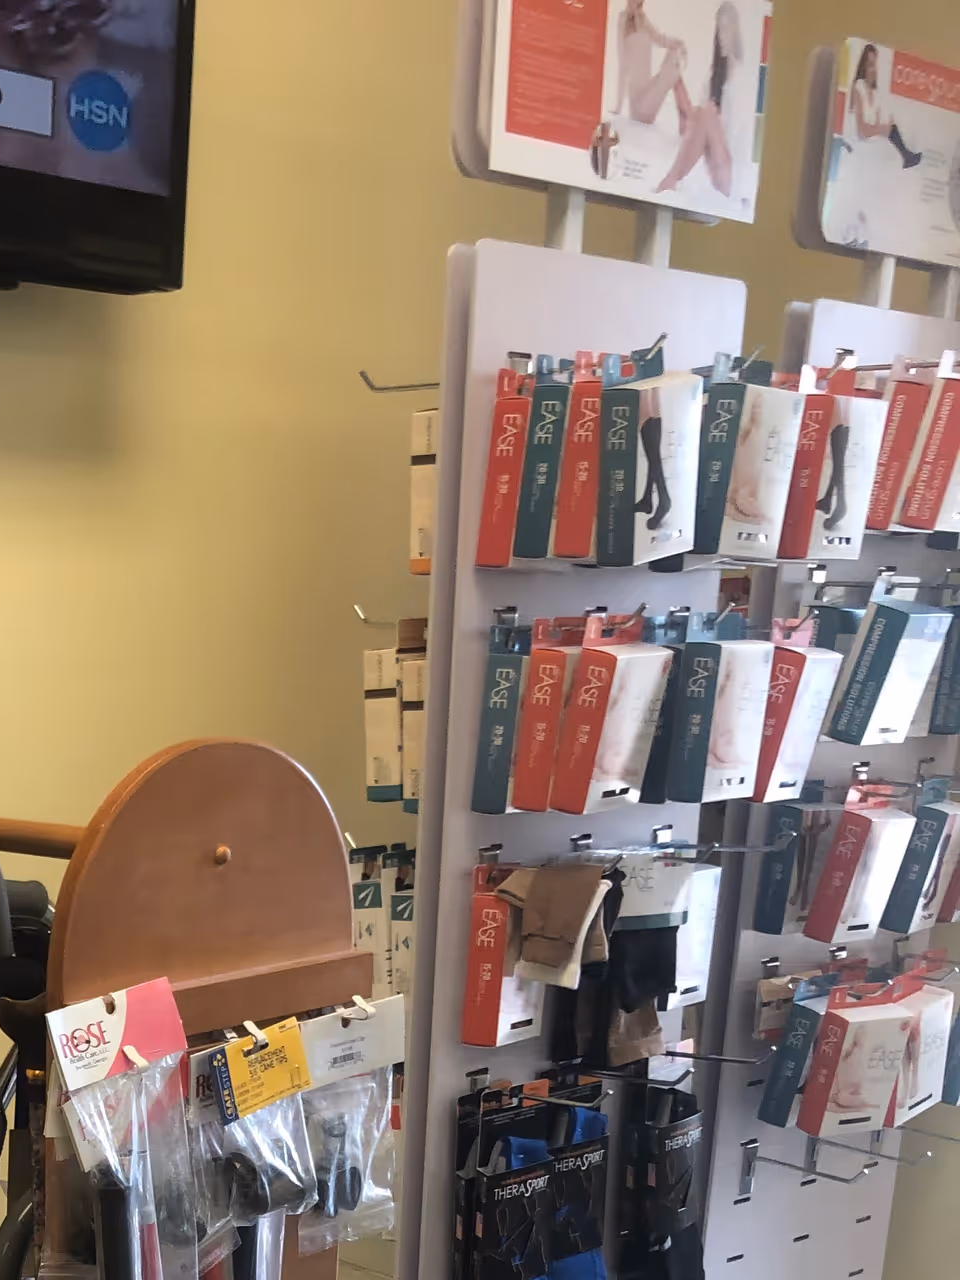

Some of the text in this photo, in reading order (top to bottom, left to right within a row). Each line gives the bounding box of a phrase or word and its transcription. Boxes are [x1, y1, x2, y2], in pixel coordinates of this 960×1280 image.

[69, 92, 129, 129] HSN
[496, 413, 522, 458] EASE
[534, 400, 560, 446] EASE
[573, 397, 600, 444] EASE
[607, 405, 630, 451] EASE
[707, 398, 737, 444] EASE
[799, 409, 824, 451] EASE
[923, 391, 955, 462] COMPRESSION
[489, 668, 513, 710] EASE
[532, 664, 557, 706] EASE
[578, 665, 605, 708] EASE
[687, 656, 712, 698] EASE
[768, 663, 795, 705] EASE
[835, 824, 862, 860] EASE
[911, 819, 937, 853] EASE
[477, 908, 500, 949] EASE
[58, 1020, 112, 1059] ROSE
[787, 1017, 811, 1050] EASE
[820, 1024, 841, 1057] EASE
[247, 1045, 286, 1069] REPLACEMENT
[867, 1048, 904, 1072] EASE
